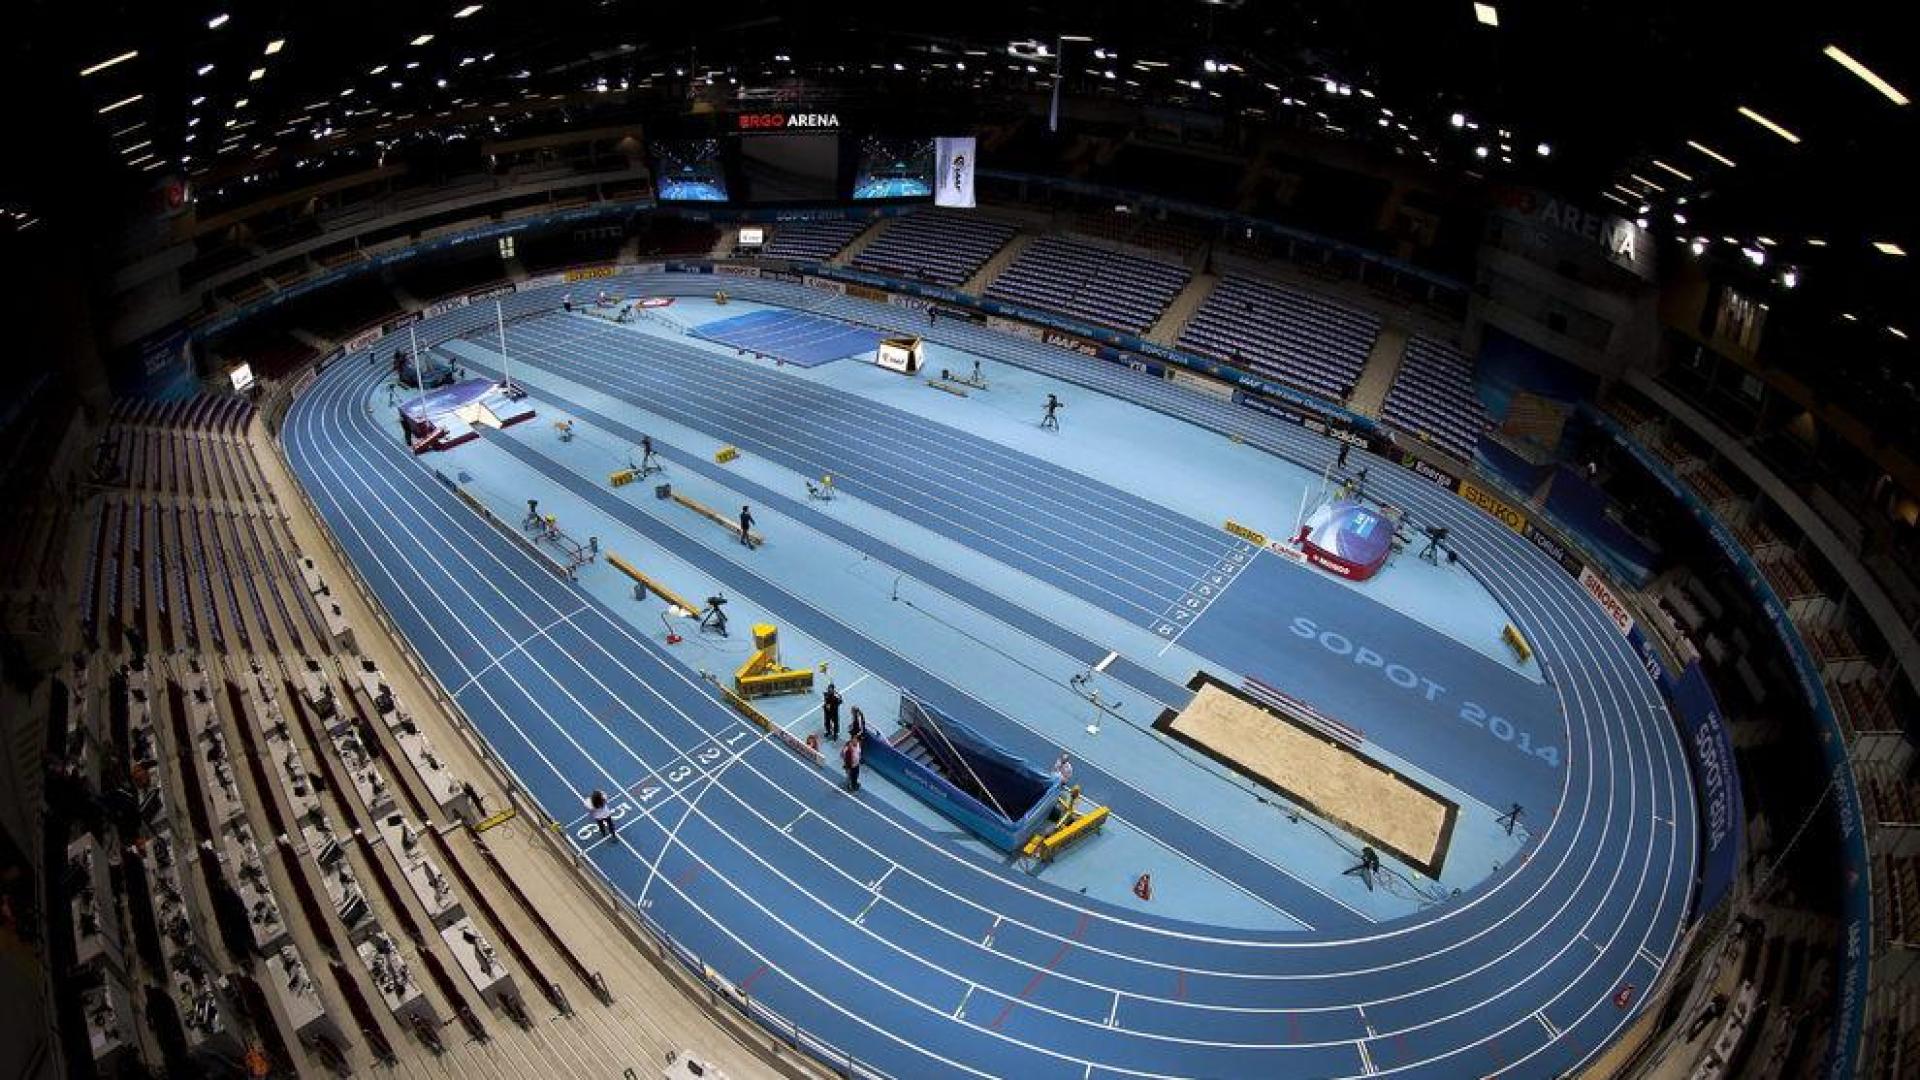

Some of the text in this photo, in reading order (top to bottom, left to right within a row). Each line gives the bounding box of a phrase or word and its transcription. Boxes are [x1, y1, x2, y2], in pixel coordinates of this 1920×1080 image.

[739, 113, 839, 128] ERGO ARENA
[1541, 198, 1637, 260] ARENA
[1465, 485, 1520, 527] SEIKO
[1586, 574, 1629, 628] SINOPEC
[1289, 616, 1560, 769] SOPOT 2014
[726, 732, 747, 746] 1
[698, 747, 721, 764] 2
[668, 765, 692, 782] 3
[639, 786, 663, 802] 4
[609, 802, 632, 821] 5
[577, 823, 600, 840] 6
